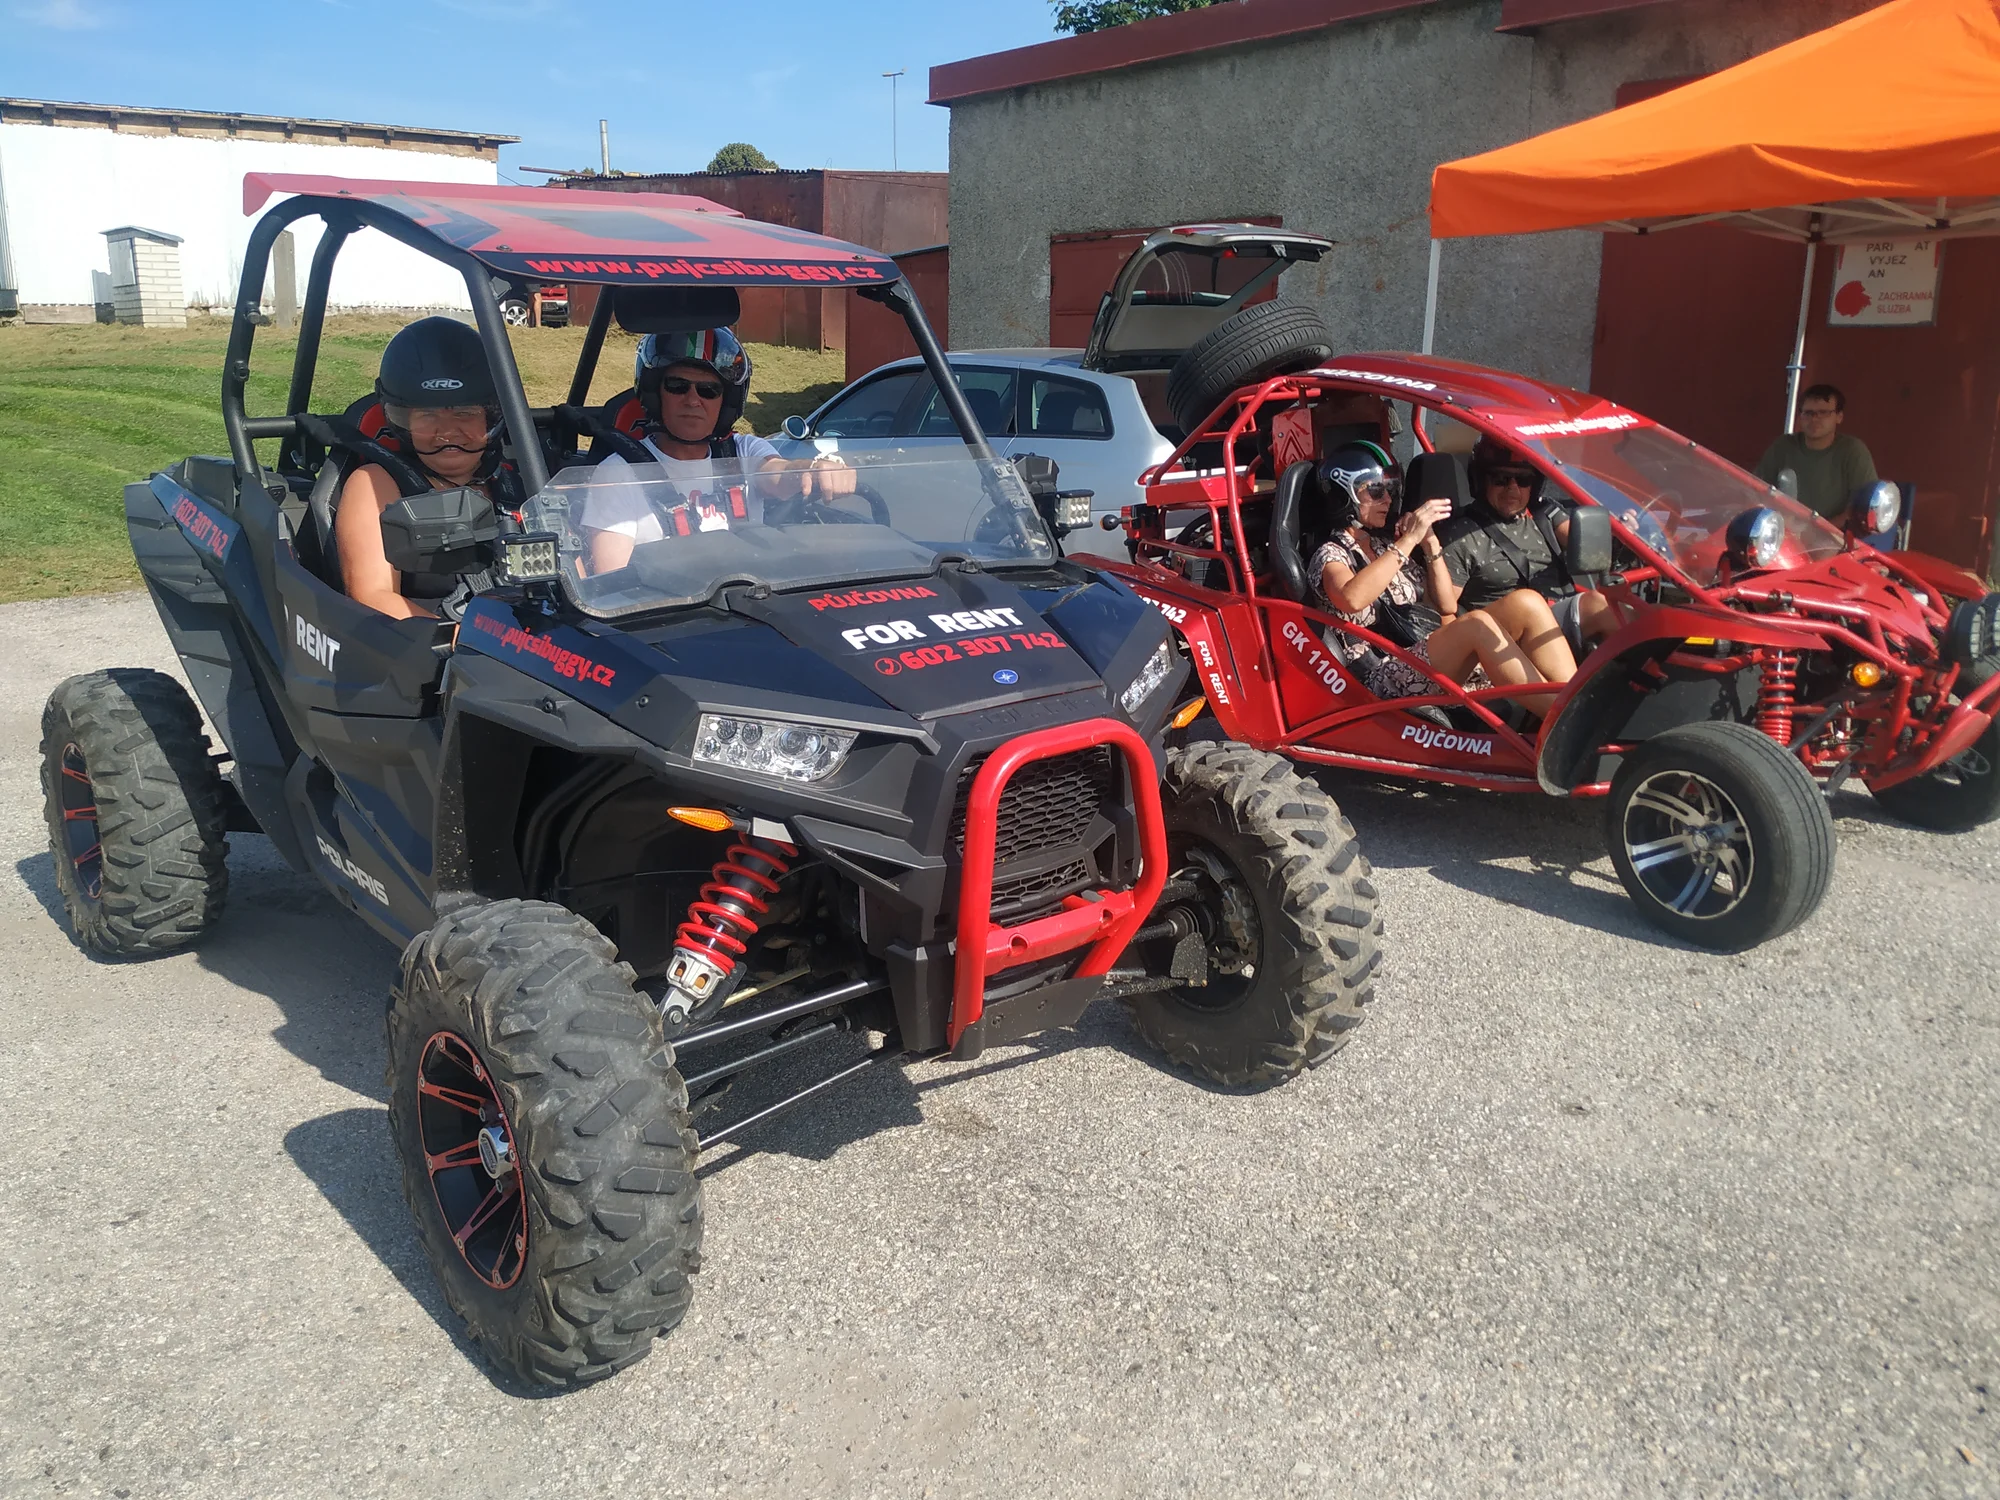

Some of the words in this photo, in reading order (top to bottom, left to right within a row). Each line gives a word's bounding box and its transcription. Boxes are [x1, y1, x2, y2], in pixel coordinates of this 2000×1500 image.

[524, 258, 885, 282] www.pujcsibuggy.cz
[1869, 255, 1908, 265] VYJEZ
[808, 586, 938, 611] PŮJČOVNA
[1160, 602, 1187, 624] 742
[295, 613, 341, 673] RENT
[841, 620, 927, 650] FOR
[928, 607, 1024, 633] RENT
[473, 612, 617, 688] www.pujcsibuggy.cz
[899, 644, 963, 670] 602
[958, 636, 1013, 658] 307
[1012, 632, 1067, 650] 742
[1282, 621, 1311, 653] GK
[1307, 649, 1347, 695] 1100
[1197, 640, 1214, 667] FOR
[1209, 673, 1229, 705] RENT
[1401, 724, 1492, 756] PŮJČOVNA
[316, 834, 390, 906] POLARIS
